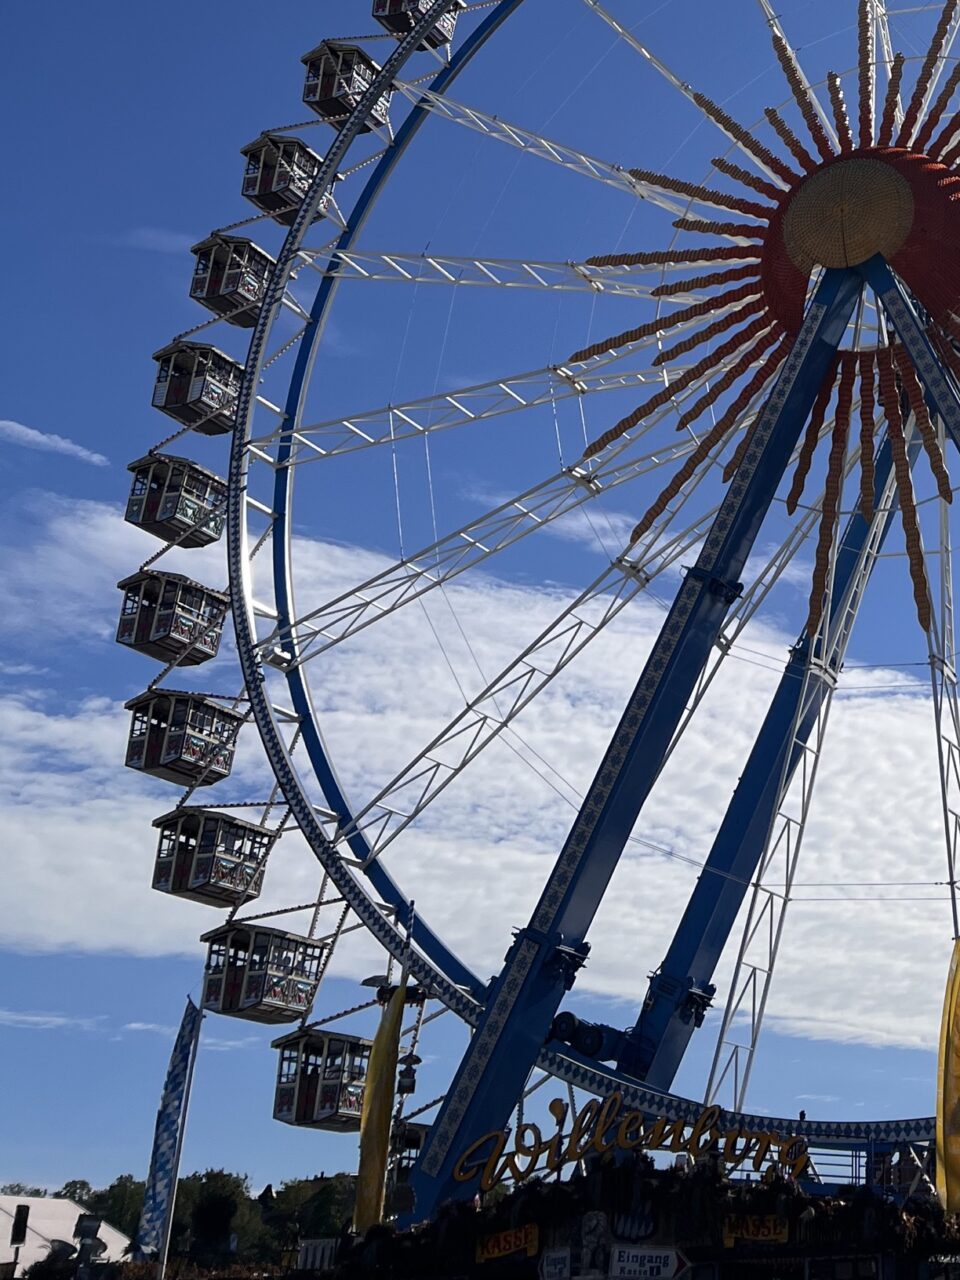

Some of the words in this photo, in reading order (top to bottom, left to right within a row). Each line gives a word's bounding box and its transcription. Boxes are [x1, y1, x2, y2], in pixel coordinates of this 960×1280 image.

[453, 1091, 809, 1192] Willenborg
[480, 1221, 532, 1255] KASSE
[728, 1216, 783, 1237] KASSE
[618, 1250, 669, 1267] Eingang
